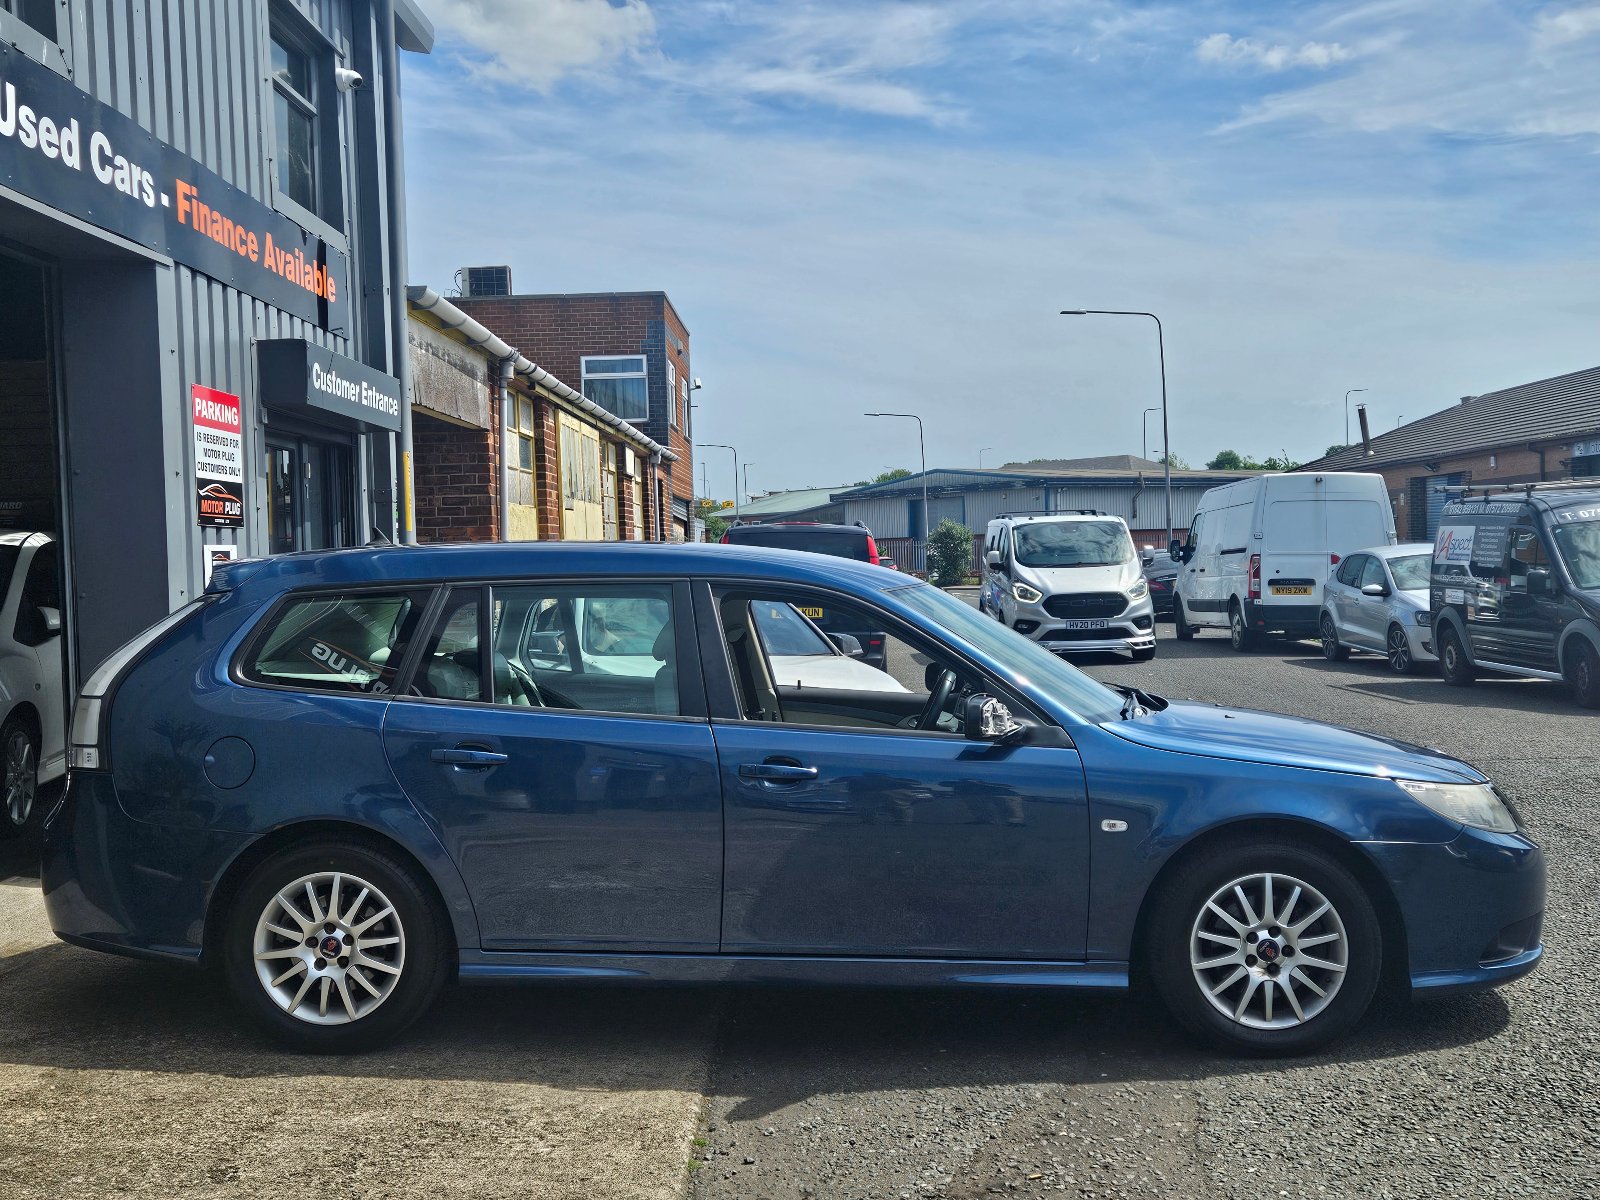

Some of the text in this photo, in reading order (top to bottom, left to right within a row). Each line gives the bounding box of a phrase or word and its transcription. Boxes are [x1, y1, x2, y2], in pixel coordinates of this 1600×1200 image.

[0, 81, 81, 171] Used
[90, 131, 155, 207] Cars
[175, 178, 259, 262] Finance
[263, 232, 337, 303] Available
[312, 362, 399, 416] Customer Entrance
[194, 397, 239, 426] PARKING
[196, 431, 240, 449] IS RESERVED FOR
[203, 447, 235, 462] MOTOR PLUG
[197, 461, 241, 477] CUSTOMERS ONLY
[201, 499, 241, 515] MOTOR PLUG
[1069, 621, 1089, 629] HV20
